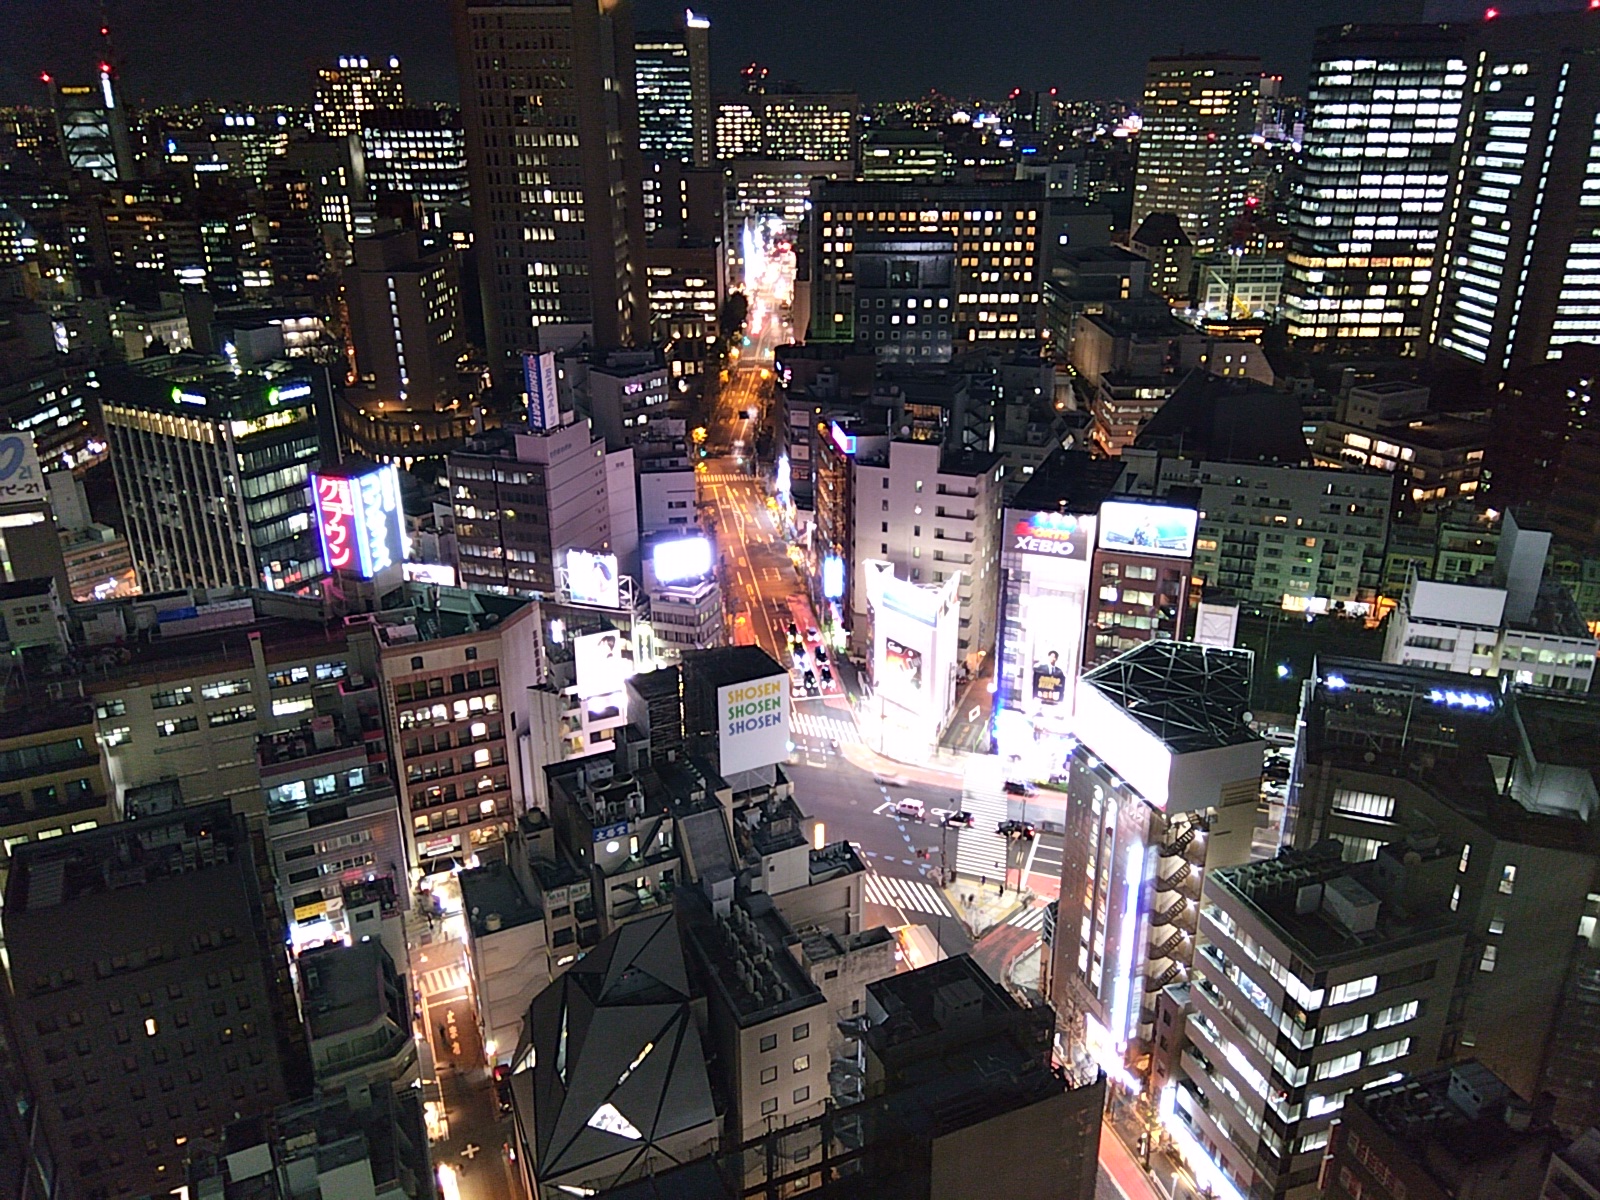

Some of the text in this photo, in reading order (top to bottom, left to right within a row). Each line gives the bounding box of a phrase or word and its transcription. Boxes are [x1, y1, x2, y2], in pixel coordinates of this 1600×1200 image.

[1015, 536, 1074, 555] XEBIO
[728, 681, 781, 704] SHOSEN
[728, 696, 781, 720] SHOSEN
[729, 712, 781, 736] SHOSEN
